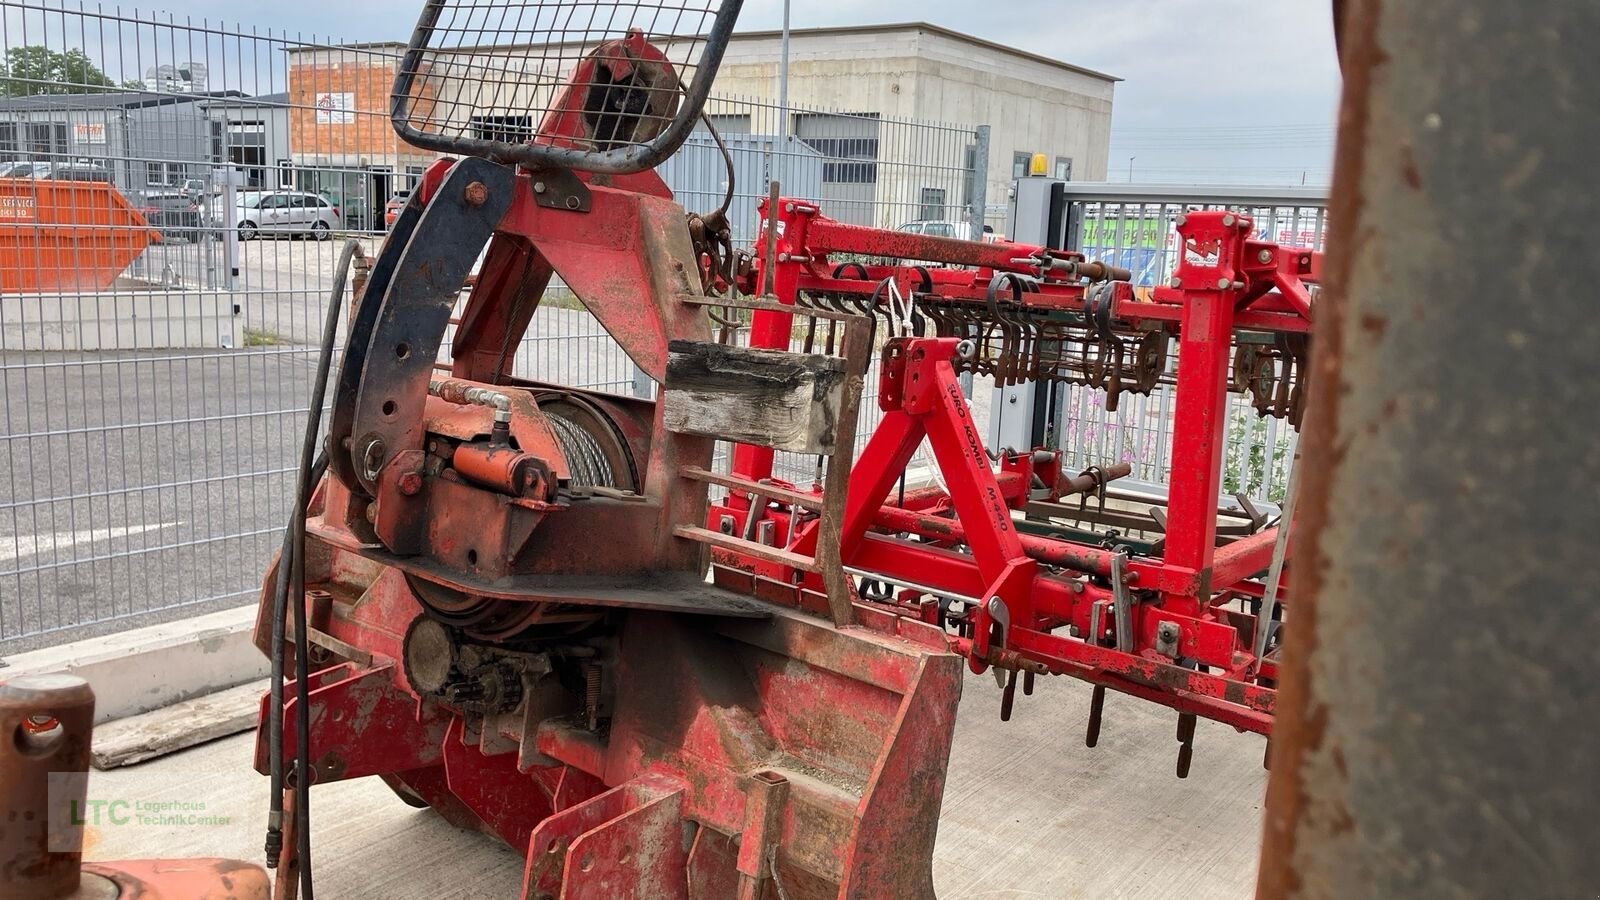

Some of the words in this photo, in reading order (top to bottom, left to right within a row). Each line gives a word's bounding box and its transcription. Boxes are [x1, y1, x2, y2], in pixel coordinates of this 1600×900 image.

[948, 383, 965, 419] EURO
[987, 486, 996, 501] M
[994, 503, 1008, 532] 440
